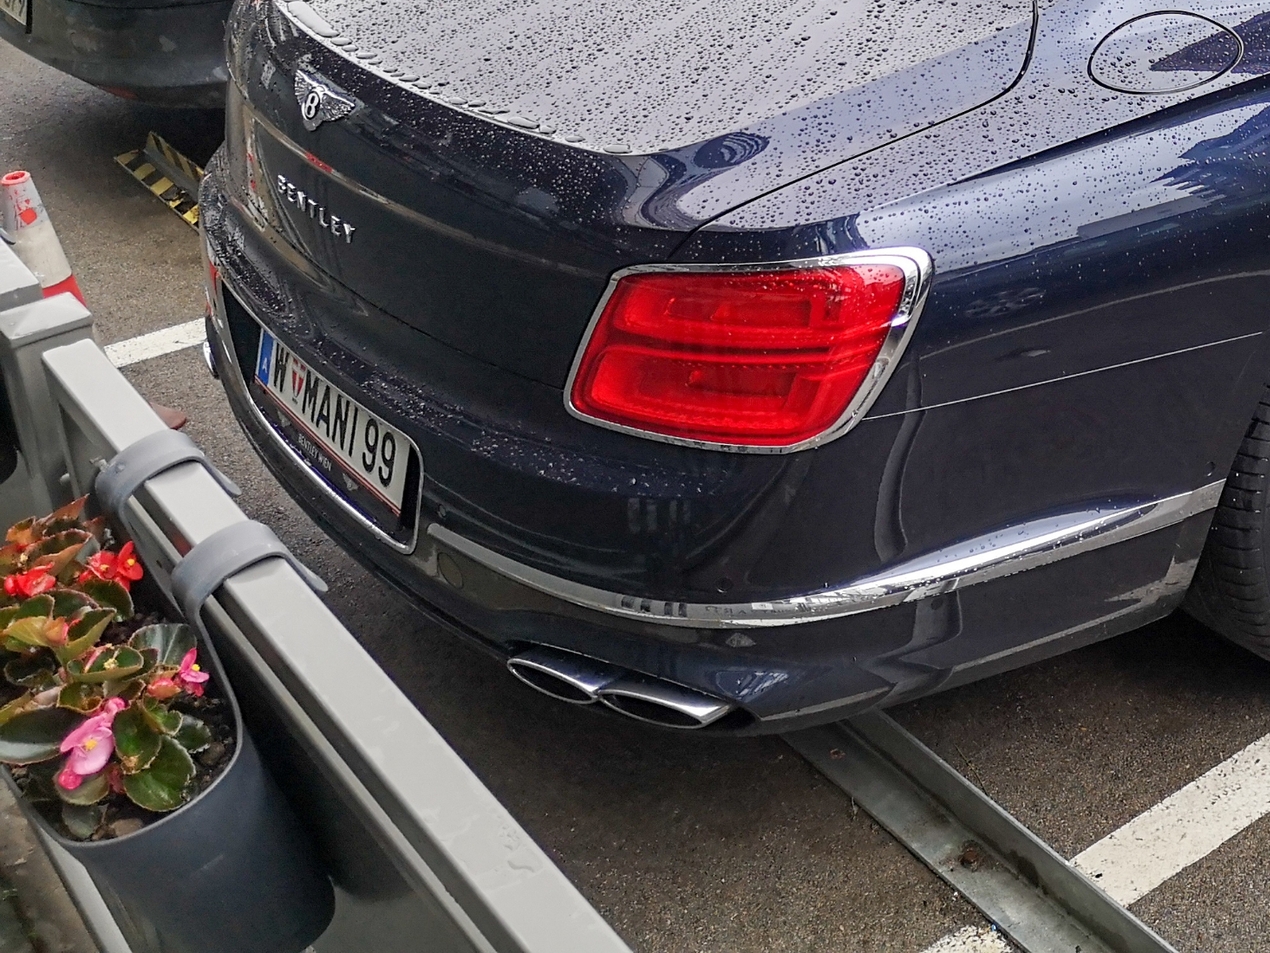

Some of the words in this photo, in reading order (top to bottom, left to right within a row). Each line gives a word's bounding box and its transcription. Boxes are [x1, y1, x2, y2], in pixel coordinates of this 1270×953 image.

[277, 174, 356, 243] BENTLEY
[298, 433, 318, 459] BENTLEY
[302, 370, 359, 458] MANI
[361, 417, 397, 488] 99
